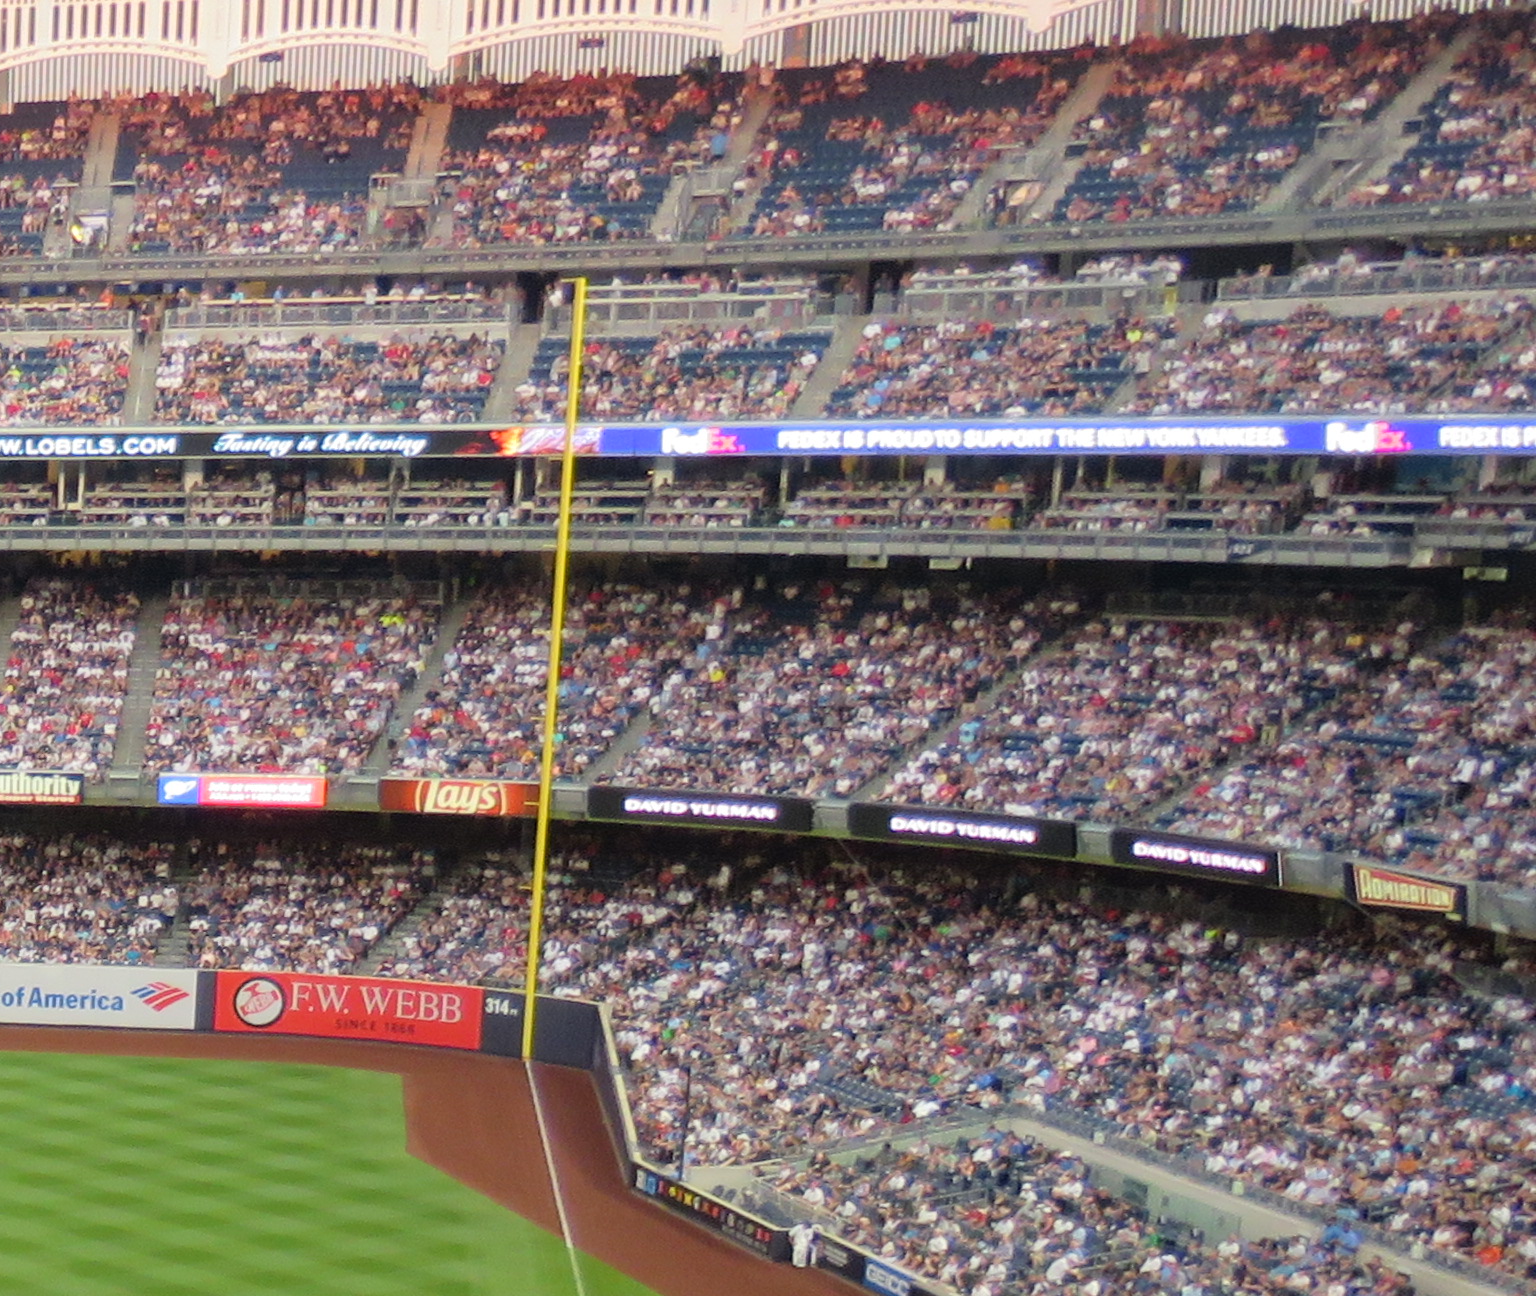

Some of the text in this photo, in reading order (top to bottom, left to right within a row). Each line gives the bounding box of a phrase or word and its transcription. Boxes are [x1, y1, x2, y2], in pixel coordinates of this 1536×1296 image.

[212, 432, 428, 458] Tasting is Believing
[778, 430, 841, 449] FEDEX
[843, 430, 863, 449] IS
[866, 429, 933, 449] PROUD
[933, 429, 962, 449] TO
[963, 428, 1054, 449] SUPPORT
[1057, 428, 1095, 448] THE
[1097, 427, 1145, 448] NEW
[1145, 427, 1196, 448] YORK
[1438, 427, 1521, 448] FEDEX IS
[624, 797, 778, 820] DAVID YURMAN
[889, 816, 1036, 844] DAVID YURMAN
[1133, 841, 1267, 874] DAVID YURMAN
[1, 986, 26, 1007] of
[28, 986, 124, 1012] America
[290, 981, 349, 1015] F.W.
[359, 985, 463, 1024] WEBB
